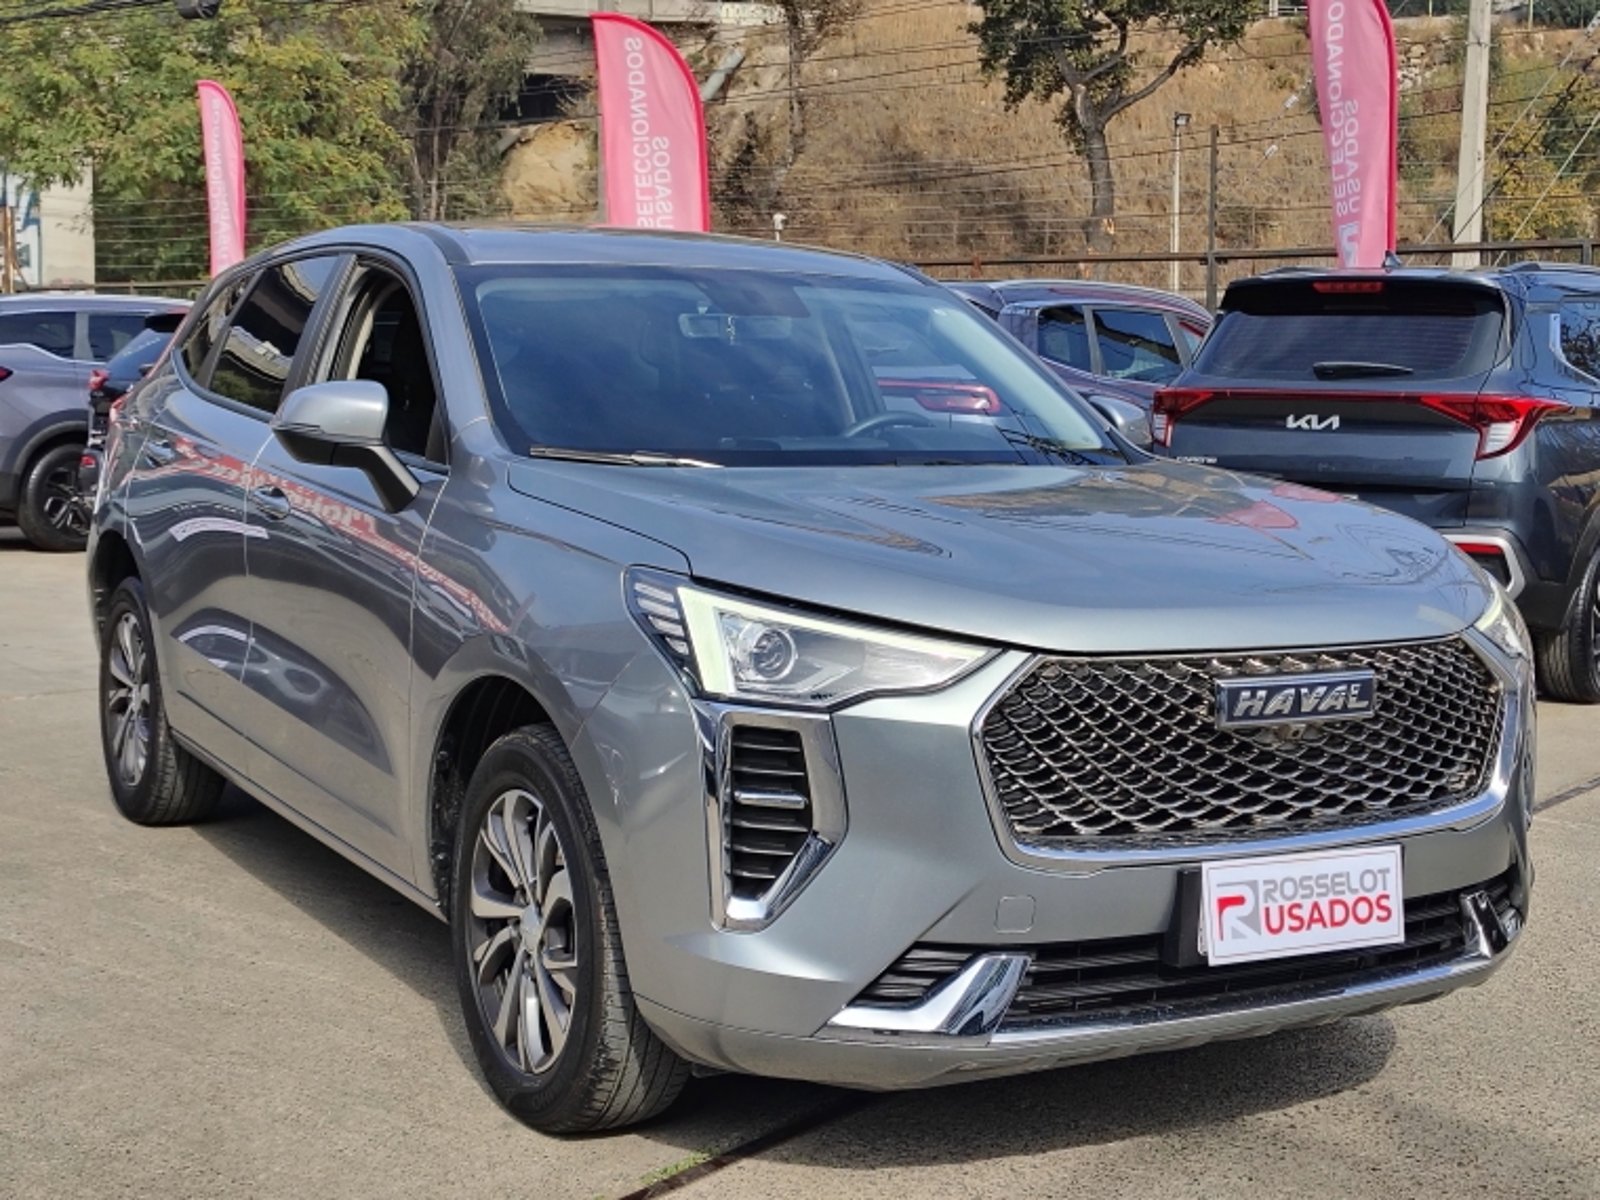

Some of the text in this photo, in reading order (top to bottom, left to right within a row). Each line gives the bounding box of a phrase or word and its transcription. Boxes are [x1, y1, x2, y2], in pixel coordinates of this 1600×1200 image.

[1286, 413, 1340, 430] KIA
[1233, 684, 1369, 717] HAVAL
[1263, 868, 1391, 904] ROSSELOT
[1264, 894, 1392, 935] USADOS
